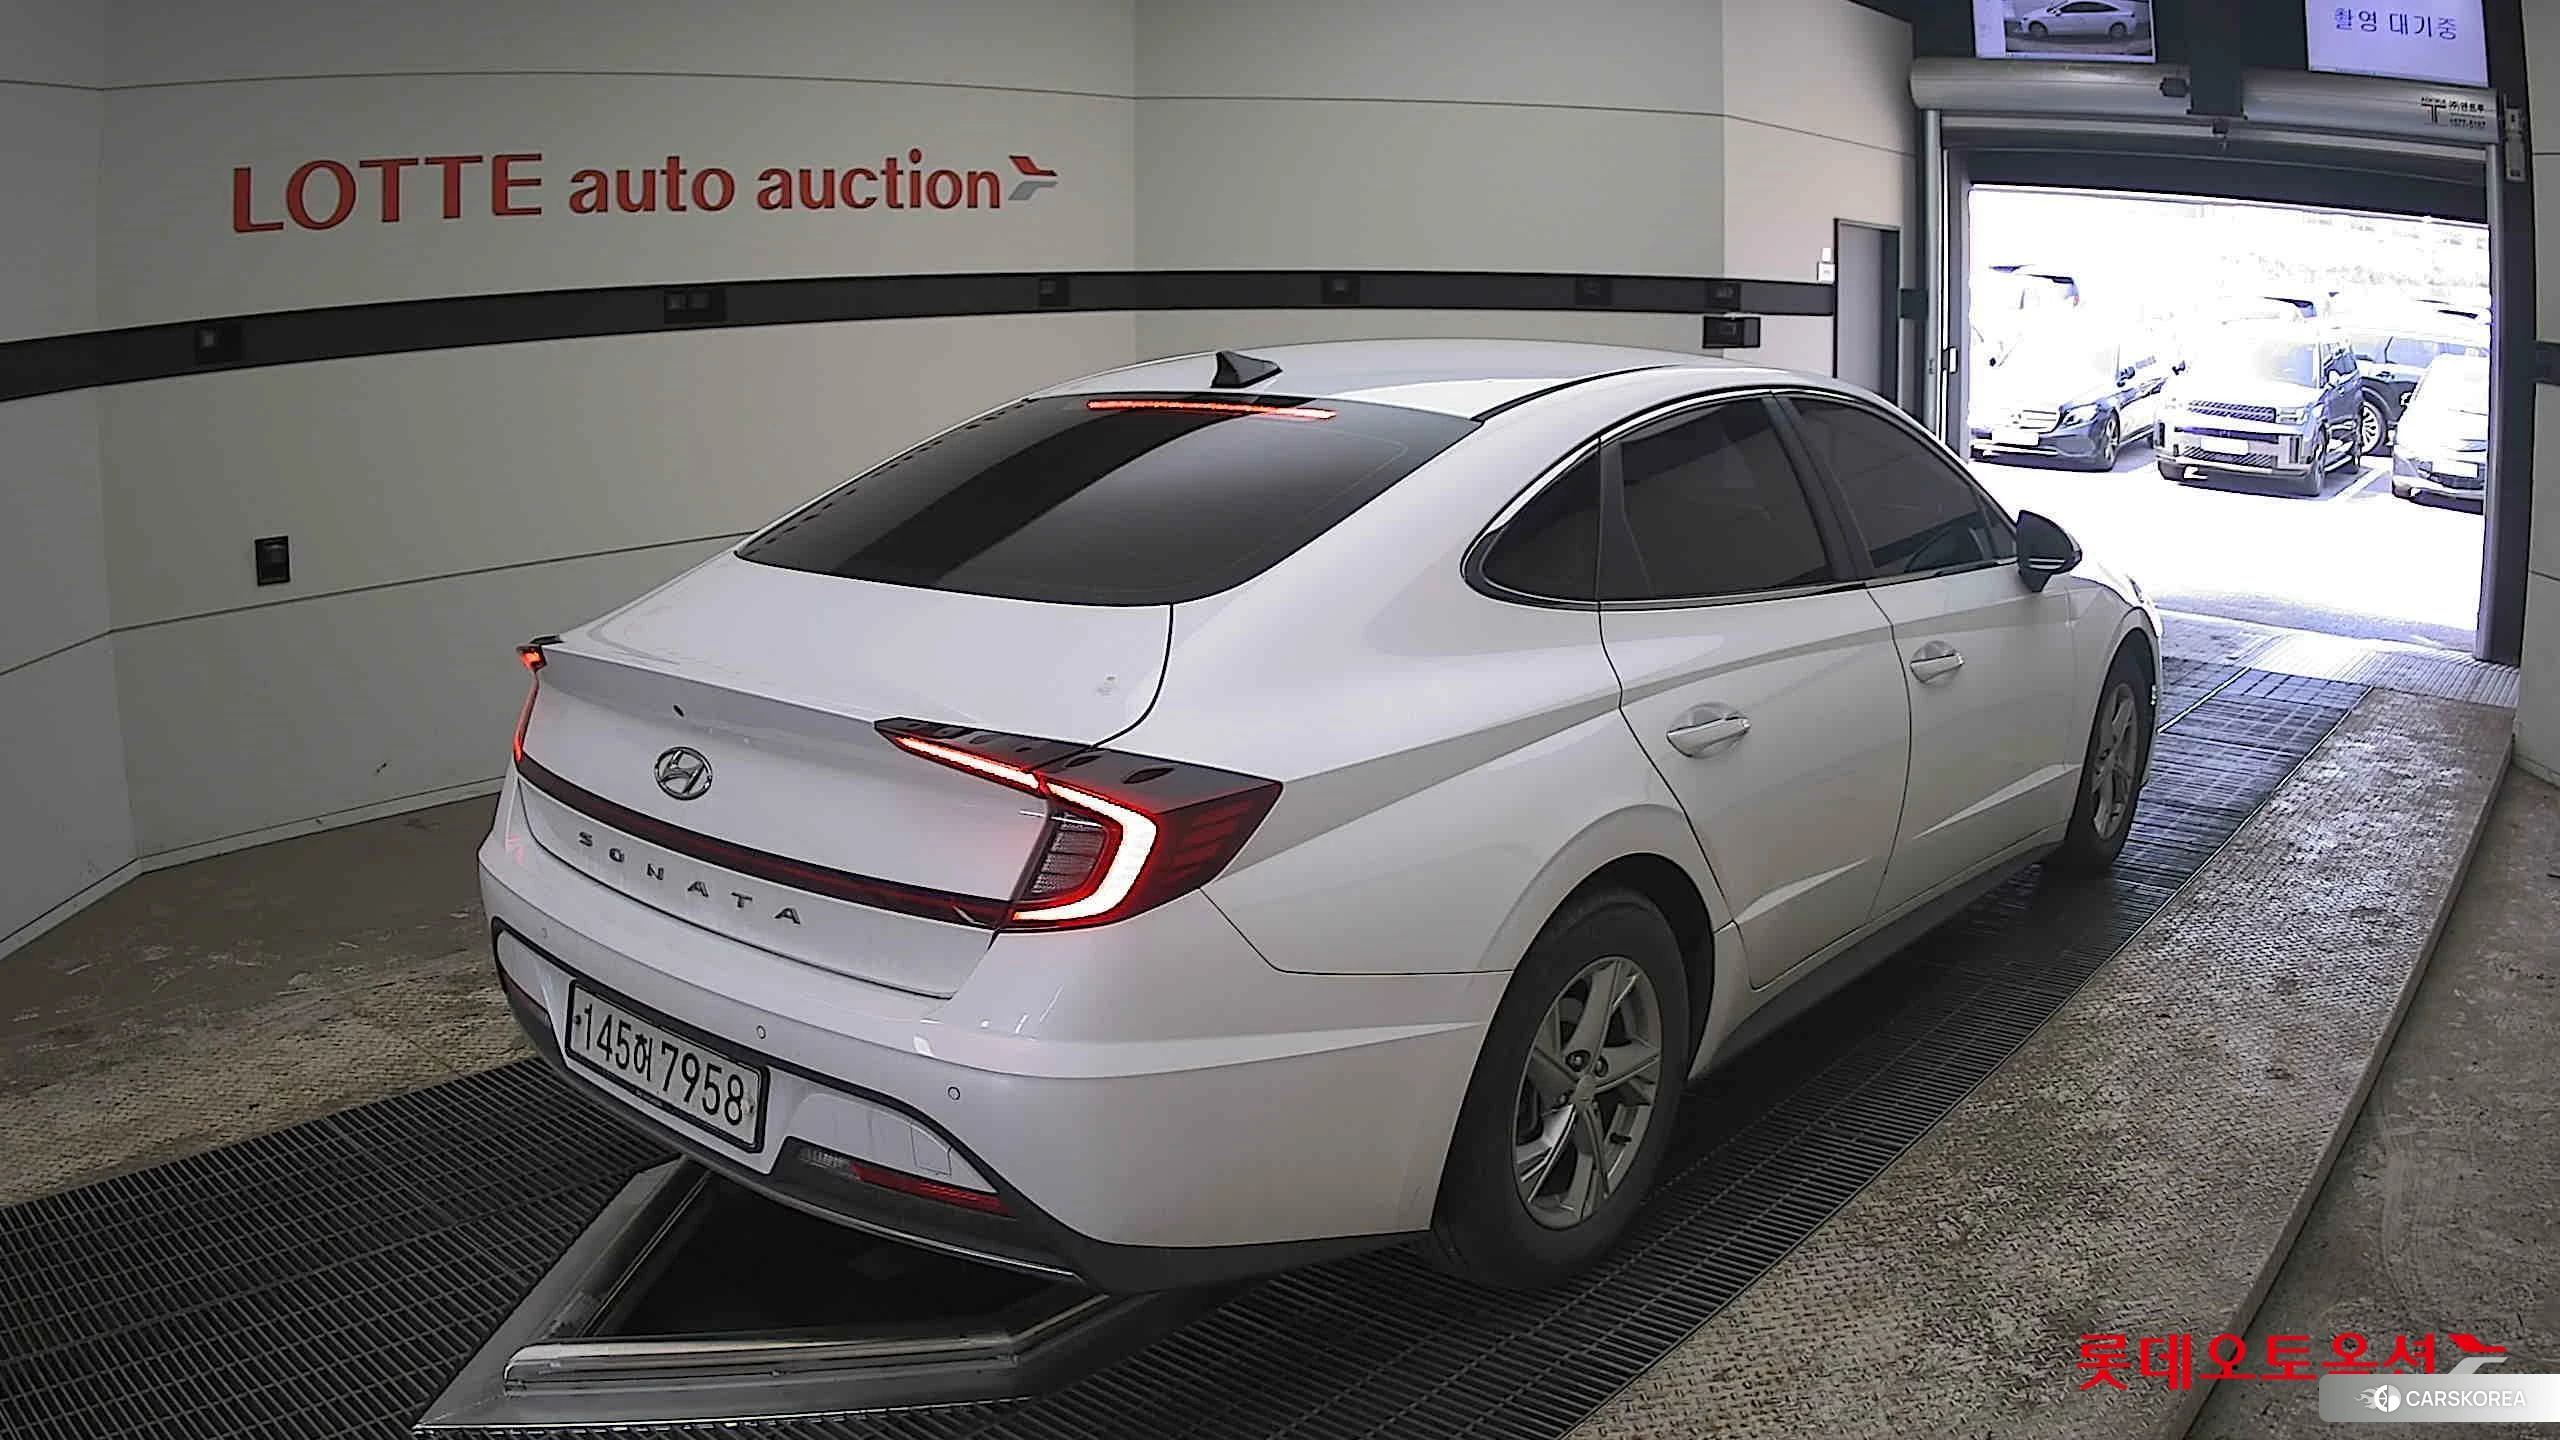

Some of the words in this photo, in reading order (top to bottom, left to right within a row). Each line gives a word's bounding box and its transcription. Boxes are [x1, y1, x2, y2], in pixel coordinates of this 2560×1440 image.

[2334, 8, 2377, 33] 촬영
[2388, 13, 2457, 41] 대기중
[232, 152, 543, 234] LOTTE
[568, 154, 736, 214] auto
[756, 147, 1001, 210] auction
[578, 831, 802, 925] SONATA
[584, 1002, 744, 1126] 145허7958
